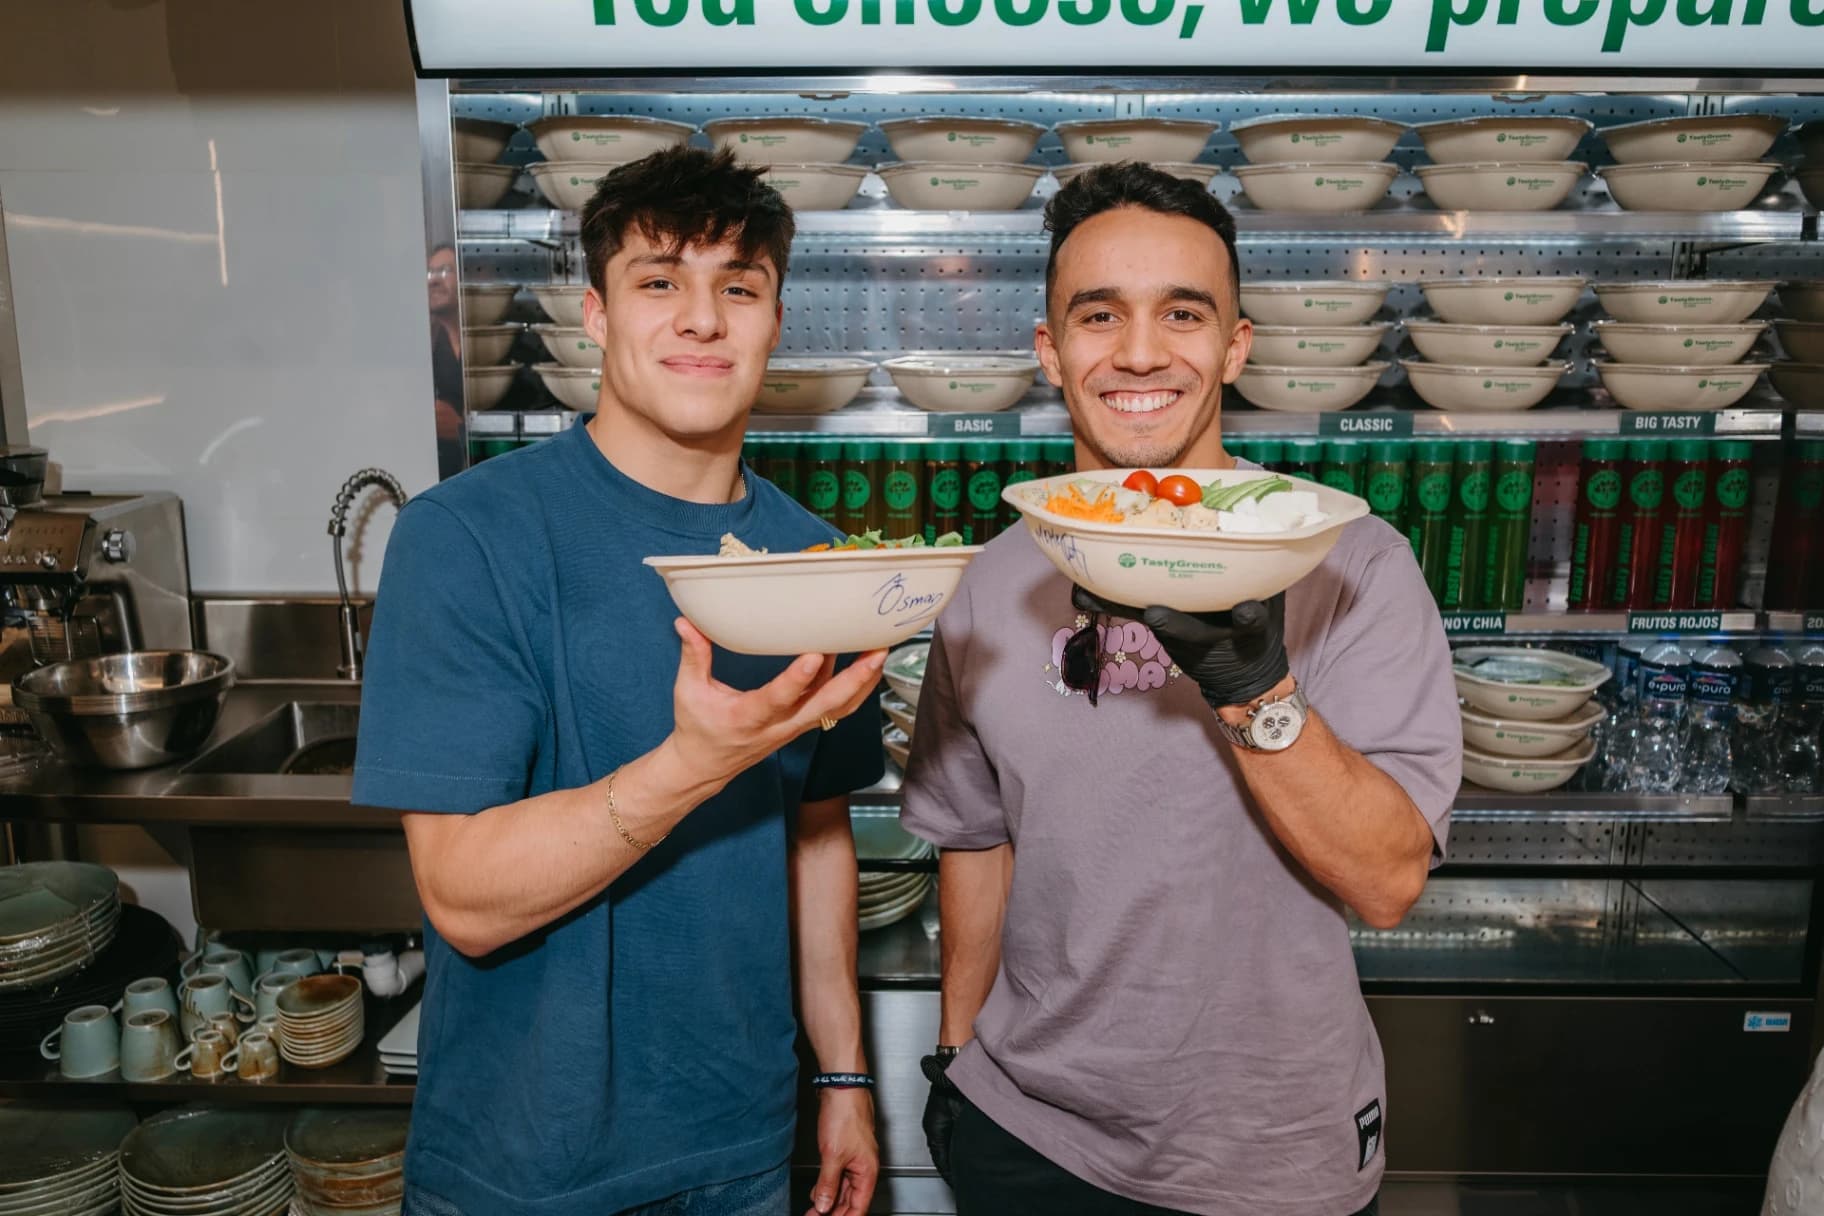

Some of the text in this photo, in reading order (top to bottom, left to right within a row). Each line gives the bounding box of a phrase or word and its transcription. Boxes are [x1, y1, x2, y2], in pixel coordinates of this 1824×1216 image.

[954, 419, 993, 432] BASIC
[1340, 418, 1393, 432] CLASSIC
[1635, 416, 1701, 429] BIG TASTY
[1472, 615, 1502, 629] CHIA
[1631, 616, 1719, 630] FRUTOS ROJOS
[1807, 616, 1824, 629] 20
